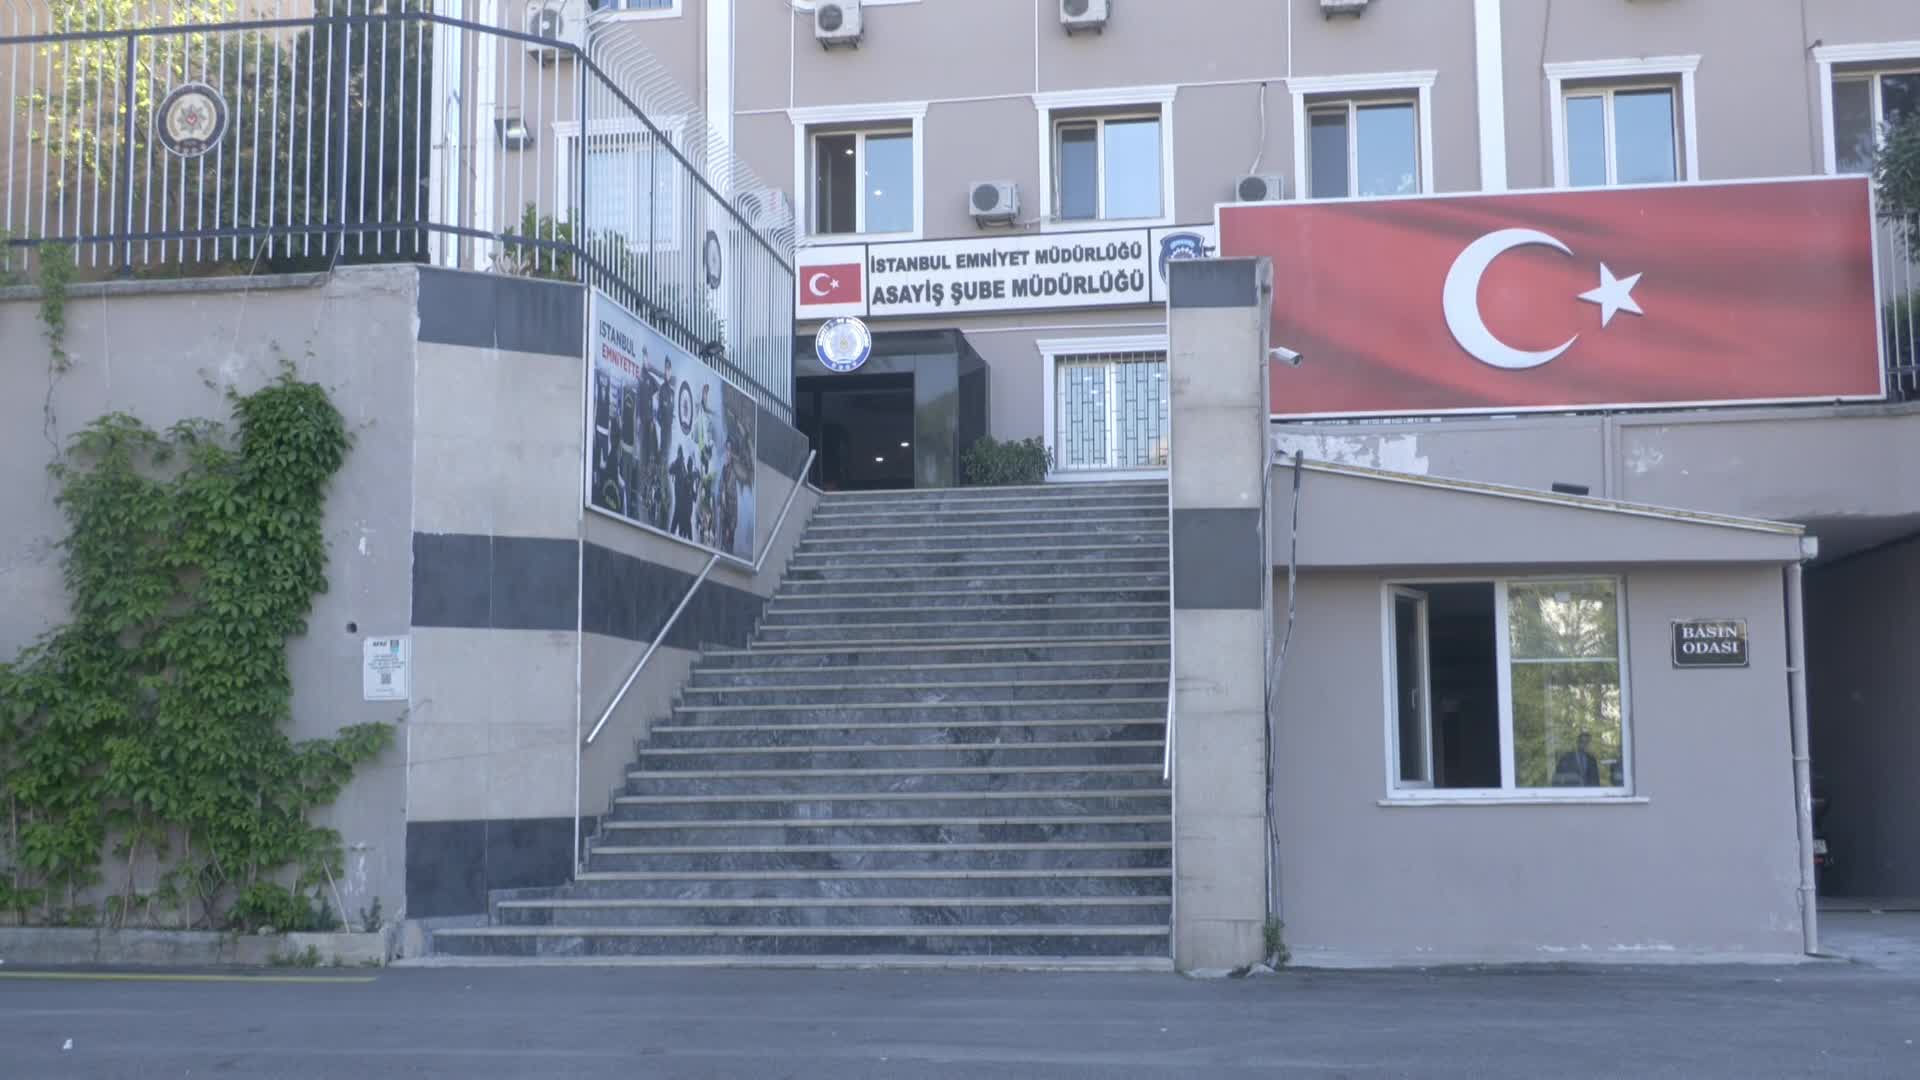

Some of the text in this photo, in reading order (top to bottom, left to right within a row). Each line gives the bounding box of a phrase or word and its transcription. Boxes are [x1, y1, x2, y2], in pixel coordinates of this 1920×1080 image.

[871, 241, 1142, 273] İSTANBUL EMNİYET MÜDÜRLÜĞÜ
[872, 268, 1144, 307] ASAYİŞ ŞUBE MÜDÜRLÜĞÜ
[1682, 626, 1737, 638] BASIN
[1682, 641, 1738, 654] ODASI
